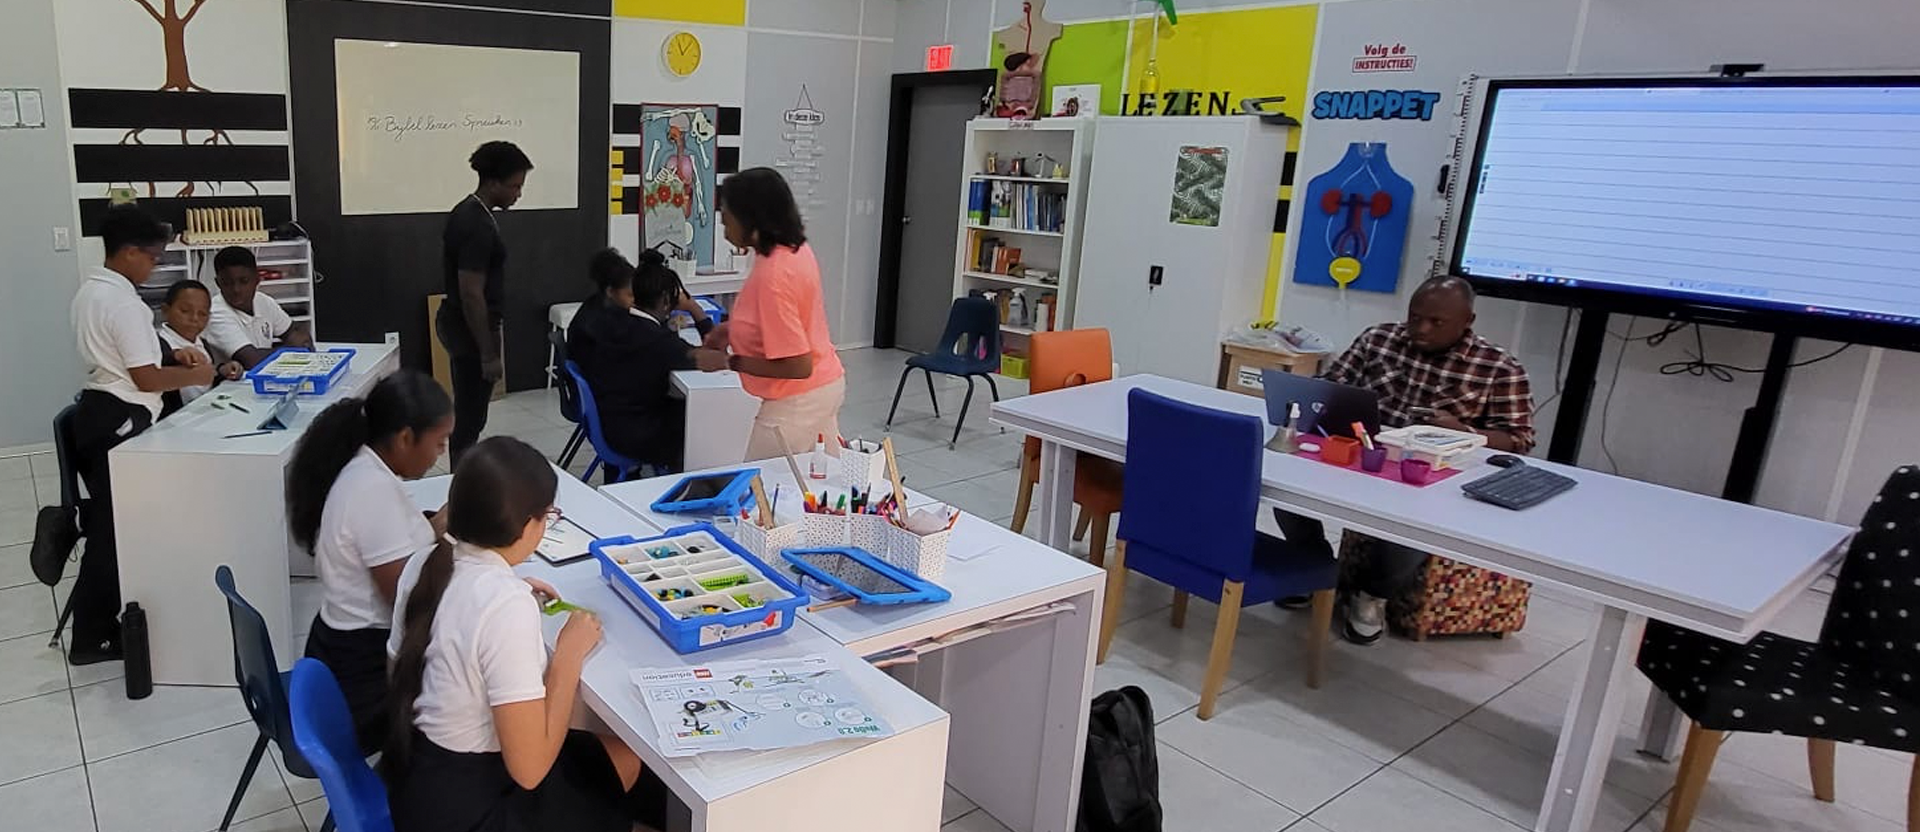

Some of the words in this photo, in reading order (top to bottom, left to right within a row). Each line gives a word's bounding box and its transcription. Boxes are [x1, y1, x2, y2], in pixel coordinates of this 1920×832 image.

[1364, 44, 1389, 57] Volg
[1391, 43, 1406, 54] de
[1355, 58, 1414, 70] INSTRUCTIES!
[1120, 91, 1231, 117] LEZEN
[1311, 89, 1441, 121] SNAPPET
